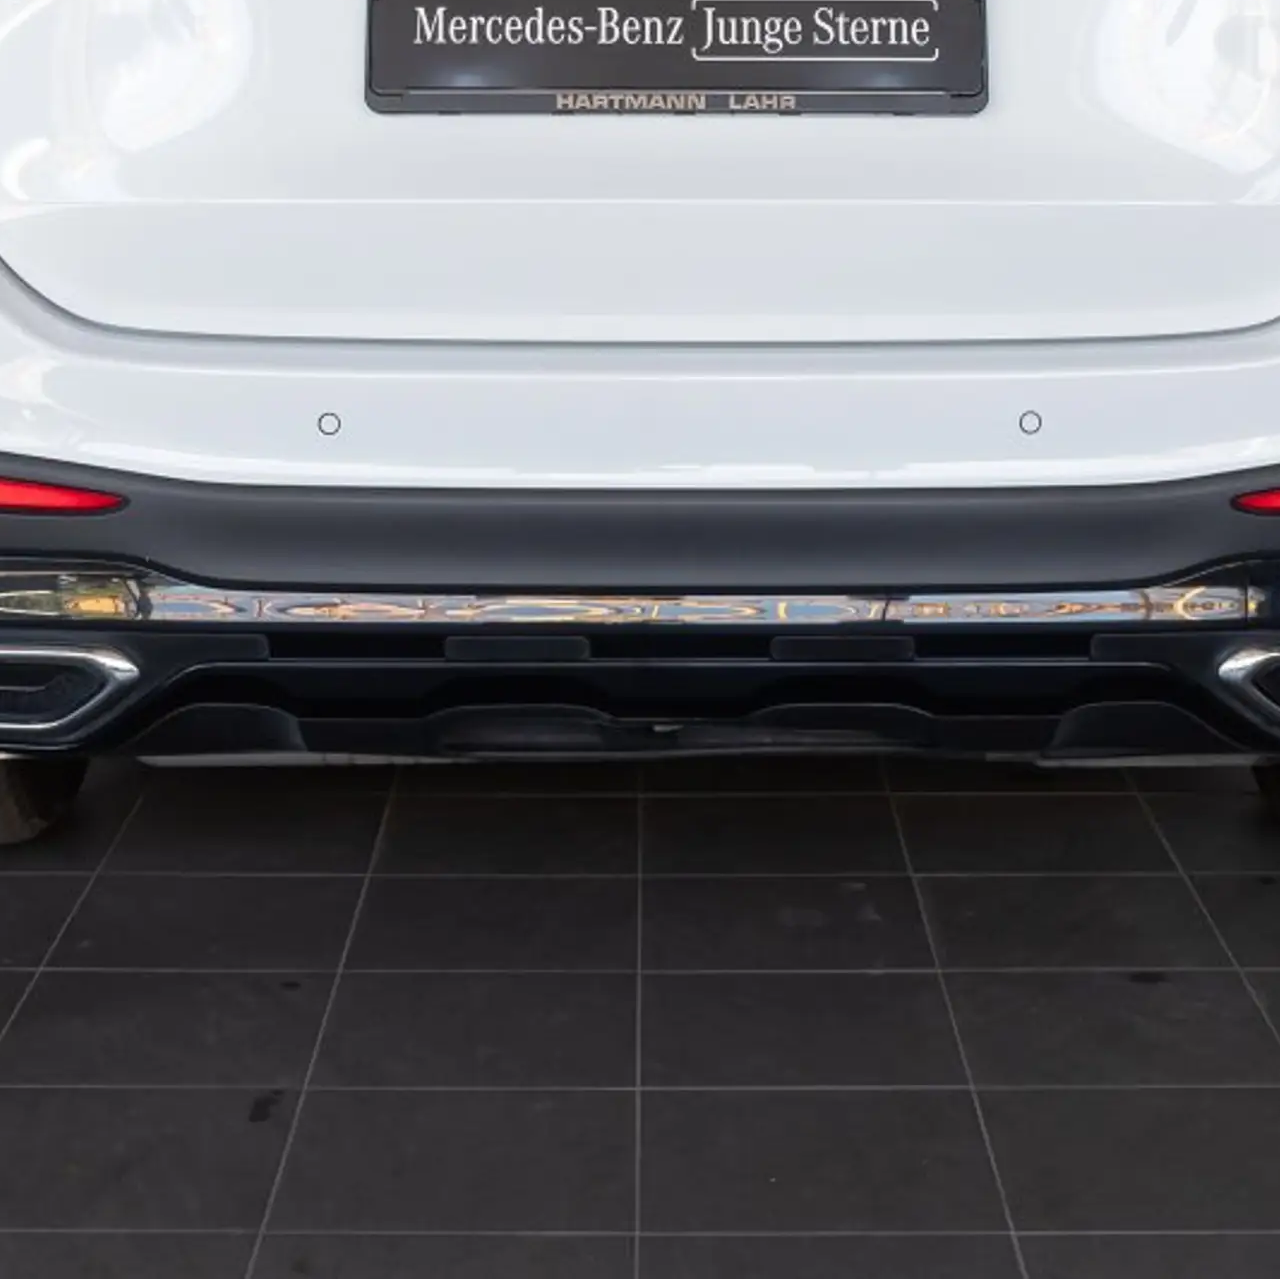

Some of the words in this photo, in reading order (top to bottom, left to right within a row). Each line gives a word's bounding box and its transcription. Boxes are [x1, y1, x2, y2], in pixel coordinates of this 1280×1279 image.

[413, 6, 684, 45] Mercedes-Benz
[701, 7, 803, 54] Junge
[813, 6, 931, 47] Sterne
[556, 94, 707, 110] HARTMANN
[728, 94, 797, 110] LAHR
